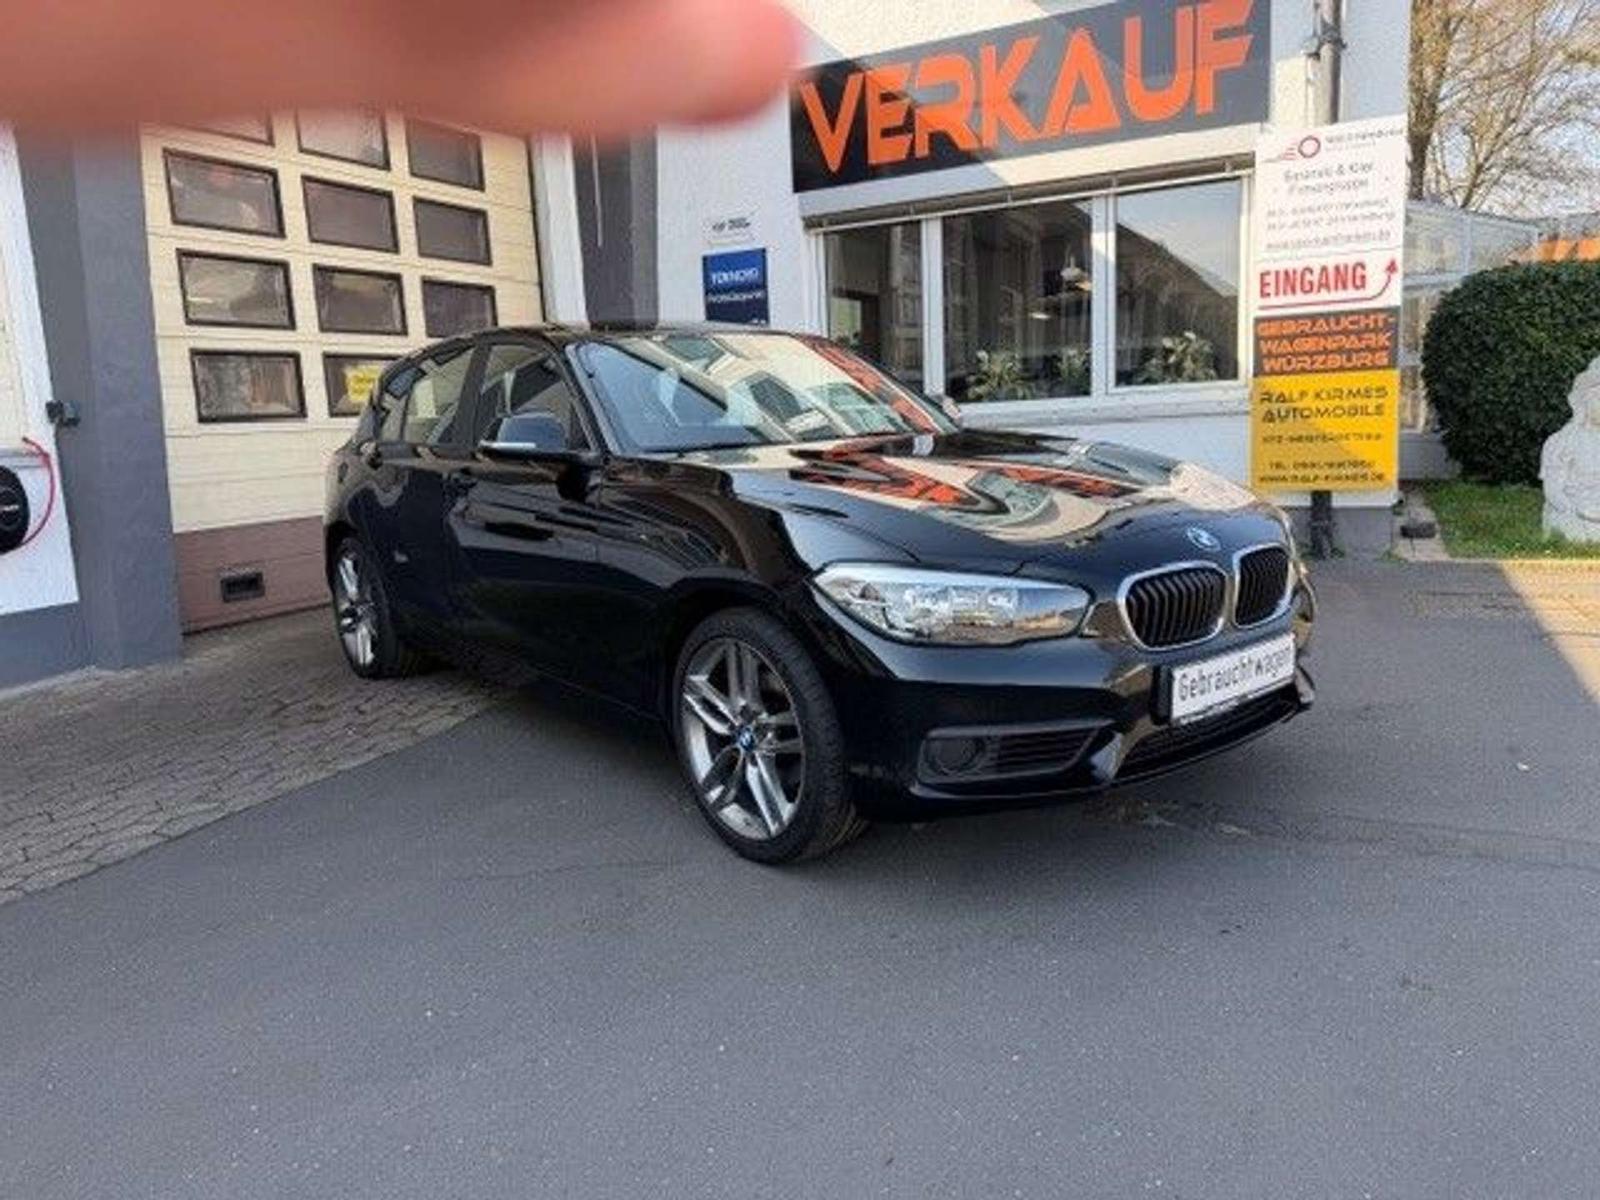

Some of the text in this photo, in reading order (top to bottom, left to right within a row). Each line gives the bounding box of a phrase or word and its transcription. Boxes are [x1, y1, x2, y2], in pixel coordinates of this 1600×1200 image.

[801, 0, 1255, 172] VERKAUF
[1259, 261, 1367, 299] EINGANG
[1257, 313, 1397, 337] GEBRAUCHT-
[1259, 332, 1393, 354] WAGENPARK
[1263, 350, 1389, 373] WÜRZBURG
[1259, 386, 1389, 405] RALF KIRMES
[1262, 403, 1386, 423] AUTOMOBILE
[1178, 646, 1292, 702] Gebrauchtwagen
